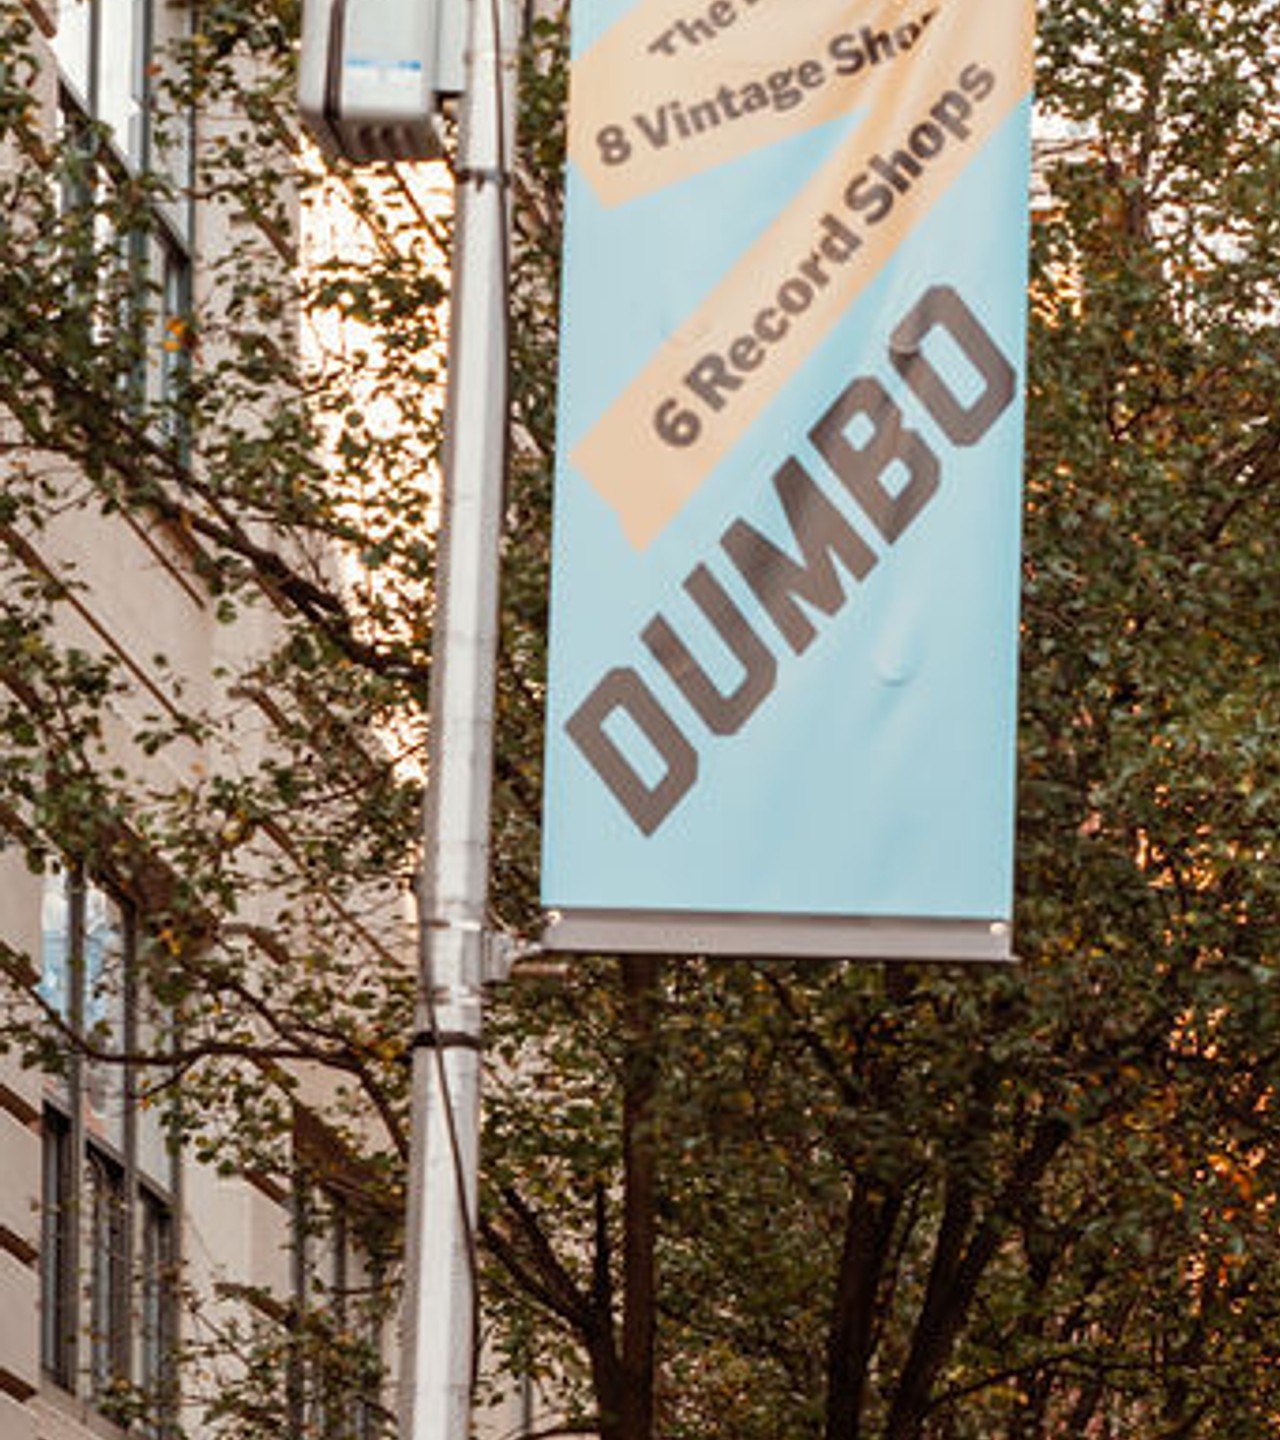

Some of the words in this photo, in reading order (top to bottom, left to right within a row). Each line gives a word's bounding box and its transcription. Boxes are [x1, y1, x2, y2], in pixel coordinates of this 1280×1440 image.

[596, 124, 632, 167] 8
[633, 58, 826, 152] Vintage
[652, 397, 703, 449] 6
[682, 214, 864, 413] Record
[843, 61, 997, 224] Shops
[563, 283, 1018, 839] DUMBO
